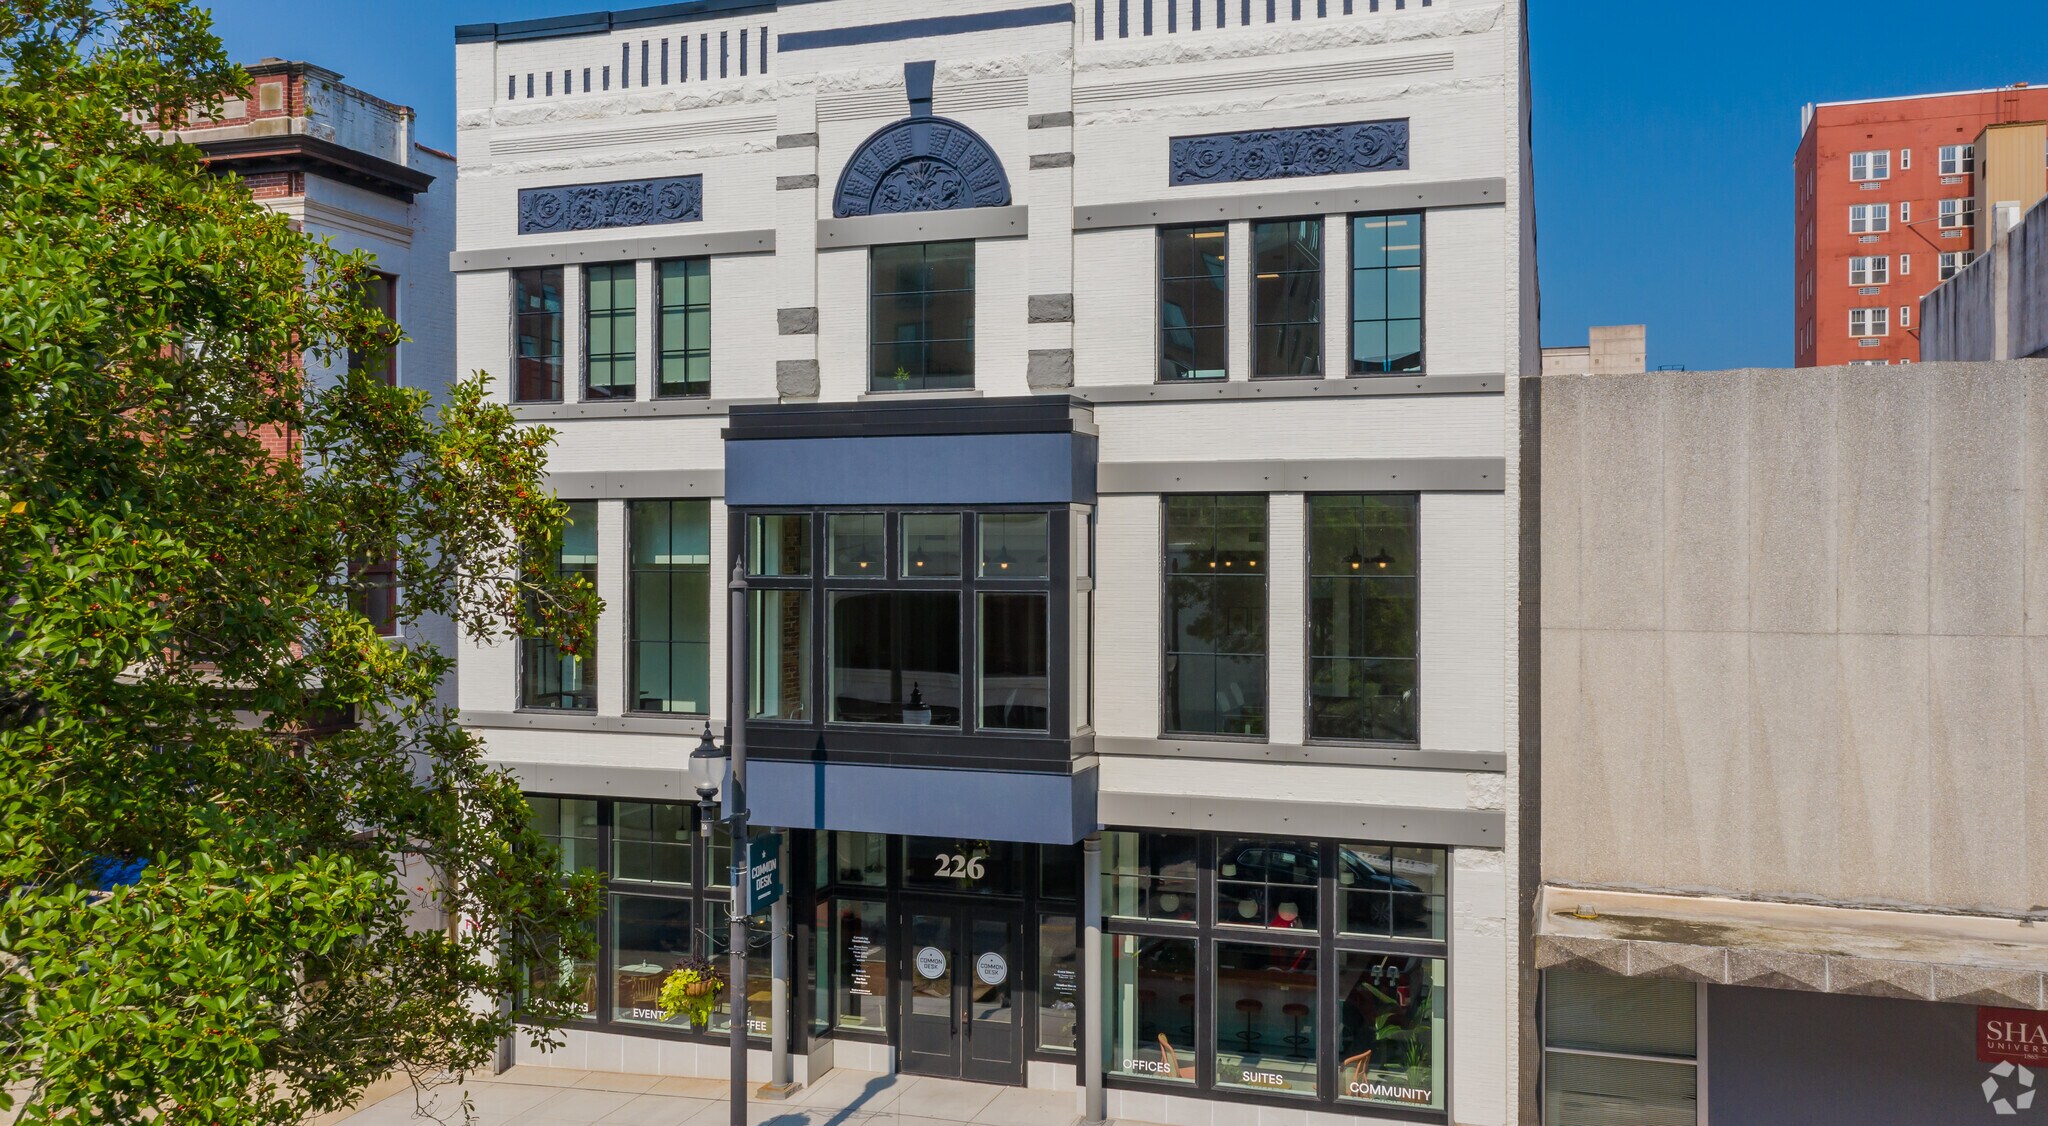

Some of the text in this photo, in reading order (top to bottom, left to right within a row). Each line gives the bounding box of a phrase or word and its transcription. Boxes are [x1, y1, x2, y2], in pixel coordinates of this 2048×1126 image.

[751, 858, 777, 880] COMMON
[934, 853, 985, 880] 226
[756, 873, 772, 891] DESK
[919, 957, 943, 965] COMMON
[980, 962, 1004, 971] COMMON
[1122, 1058, 1171, 1074] OFFICES
[1242, 1070, 1284, 1086] SUITES
[1349, 1081, 1432, 1101] COMMUNITY
